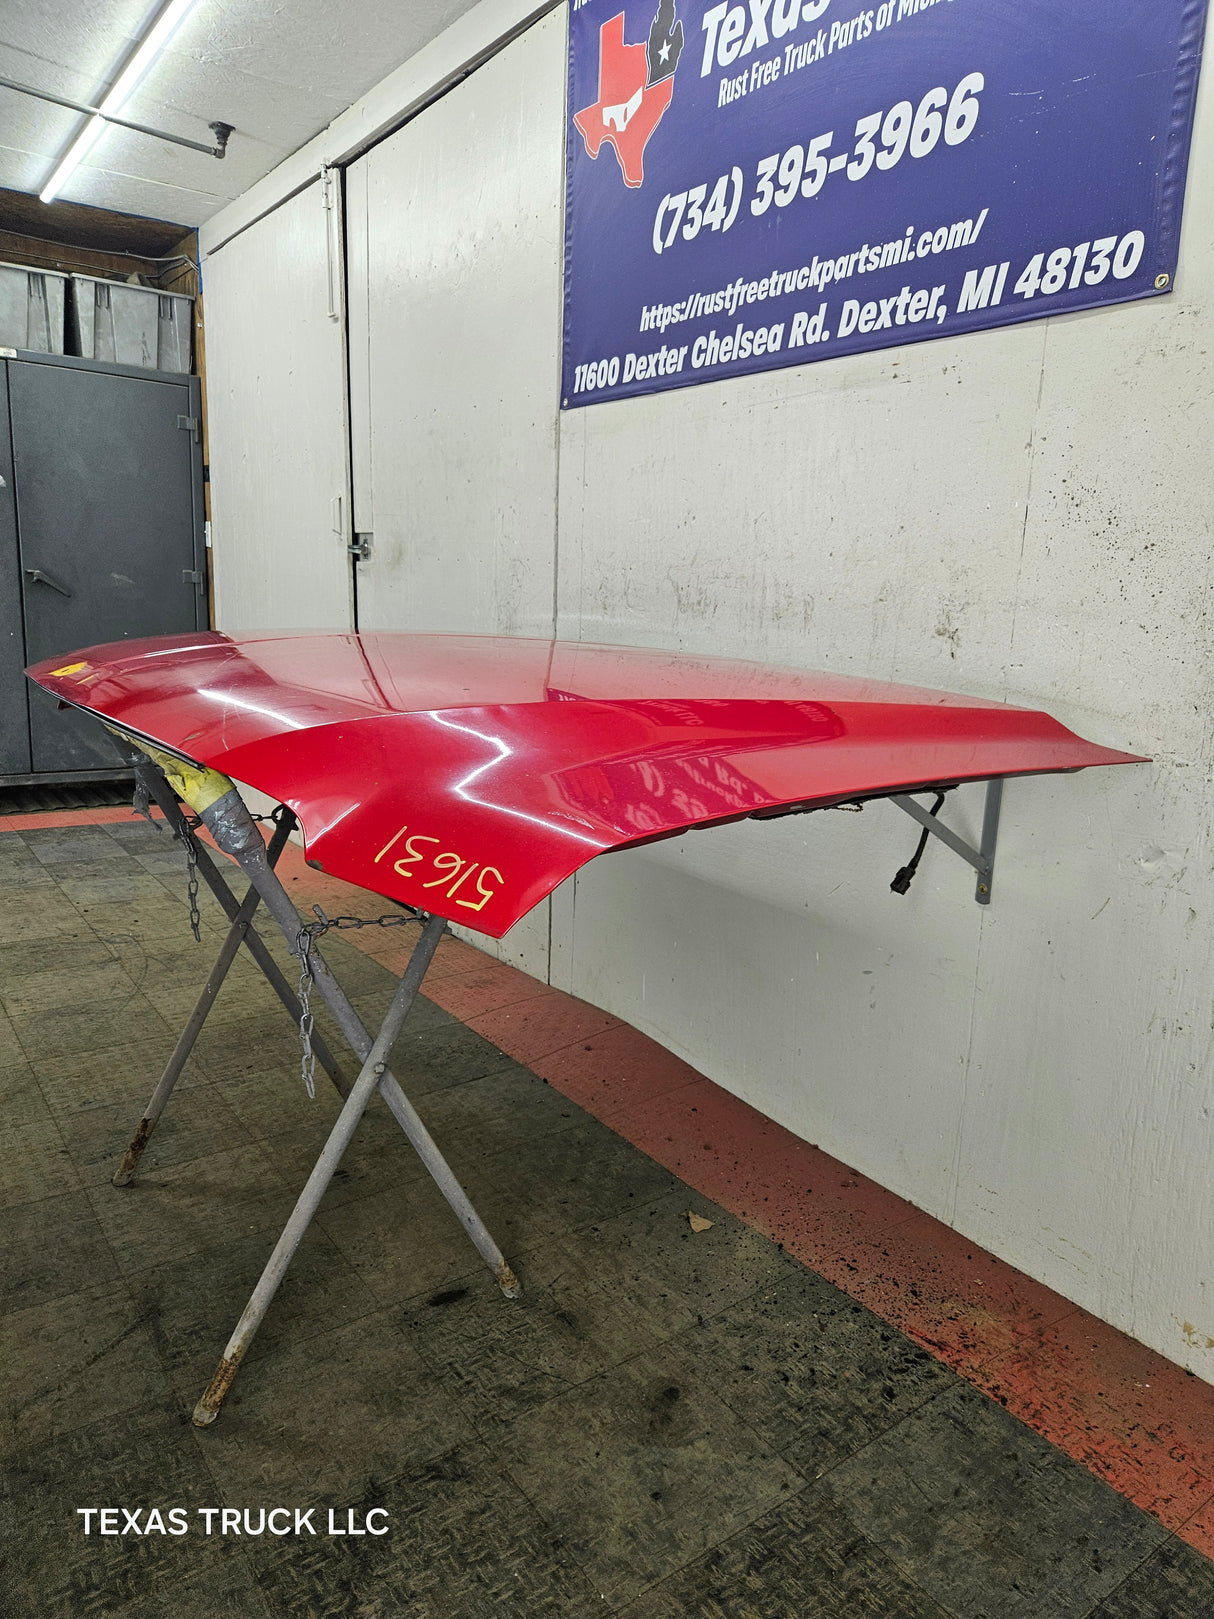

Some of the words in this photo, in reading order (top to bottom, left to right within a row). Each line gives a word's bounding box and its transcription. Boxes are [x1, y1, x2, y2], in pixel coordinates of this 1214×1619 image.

[717, 69, 749, 108] Rust
[750, 56, 782, 93] Free
[783, 28, 828, 76] Truck
[828, 9, 875, 55] Parts
[875, 0, 897, 32] of
[652, 166, 744, 255] (734)
[750, 71, 985, 216] 395-3966
[573, 356, 620, 394] 11600
[622, 345, 689, 384] Dexter
[691, 322, 785, 369] Chelsea
[787, 302, 830, 349] Rd.
[836, 284, 947, 338] Dexter,
[956, 261, 1011, 313] MI
[1013, 230, 1145, 299] 48130
[639, 207, 990, 334] https://rustfreetruckpartsmi.com/
[374, 825, 505, 912] 51631
